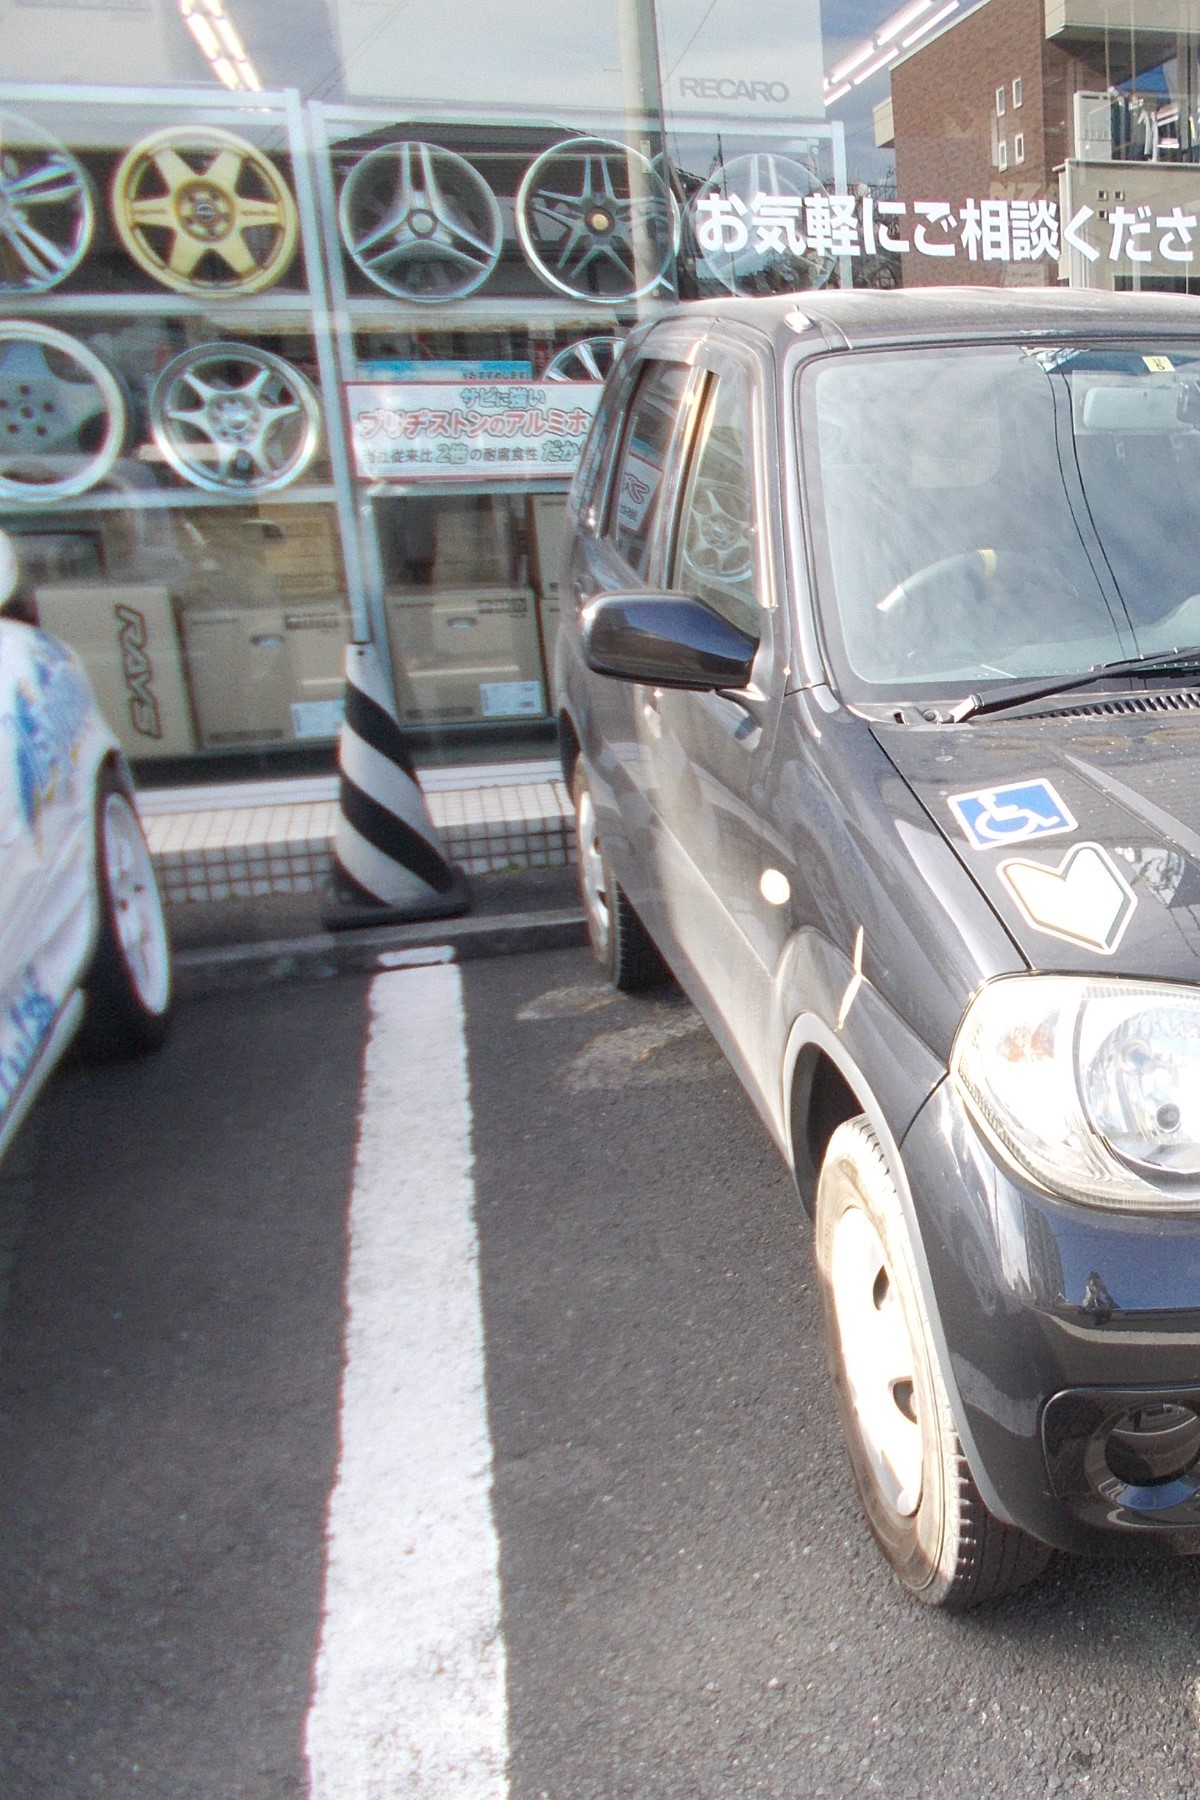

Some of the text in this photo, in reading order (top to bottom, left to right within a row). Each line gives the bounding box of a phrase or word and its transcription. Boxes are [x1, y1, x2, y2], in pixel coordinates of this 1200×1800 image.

[679, 77, 790, 103] RECARO
[460, 386, 547, 409] サビに強い
[357, 407, 593, 439] ブリヂストンのアルミホ
